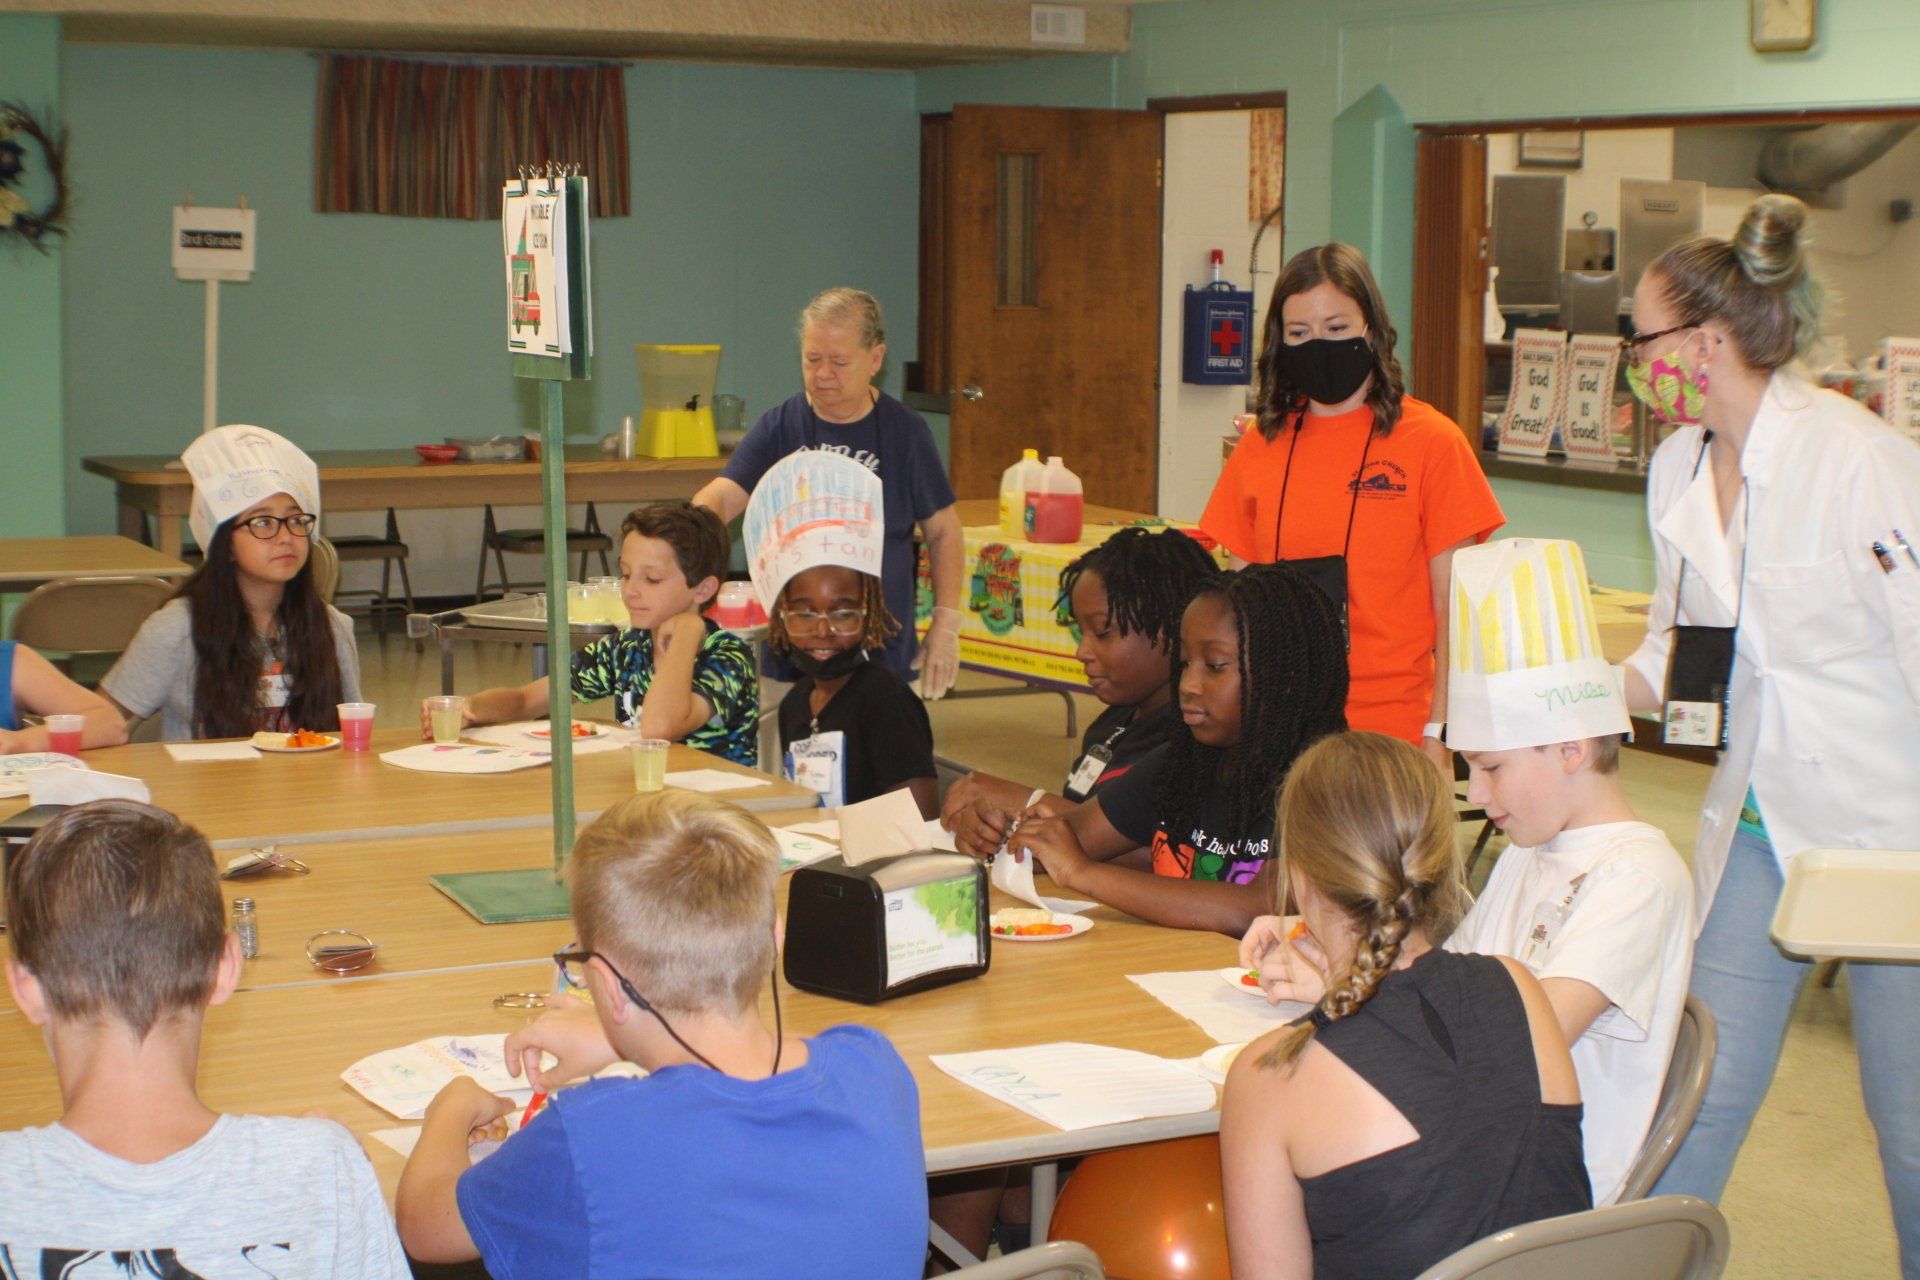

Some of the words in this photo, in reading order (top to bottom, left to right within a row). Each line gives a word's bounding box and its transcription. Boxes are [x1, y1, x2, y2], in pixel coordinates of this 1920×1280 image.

[1207, 358, 1228, 367] FIRST
[1229, 359, 1243, 367] AID
[1529, 368, 1549, 387] God
[1579, 374, 1599, 392] God
[1511, 413, 1548, 434] Great!
[1571, 420, 1600, 441] Good!
[1381, 459, 1407, 479] CHURCH
